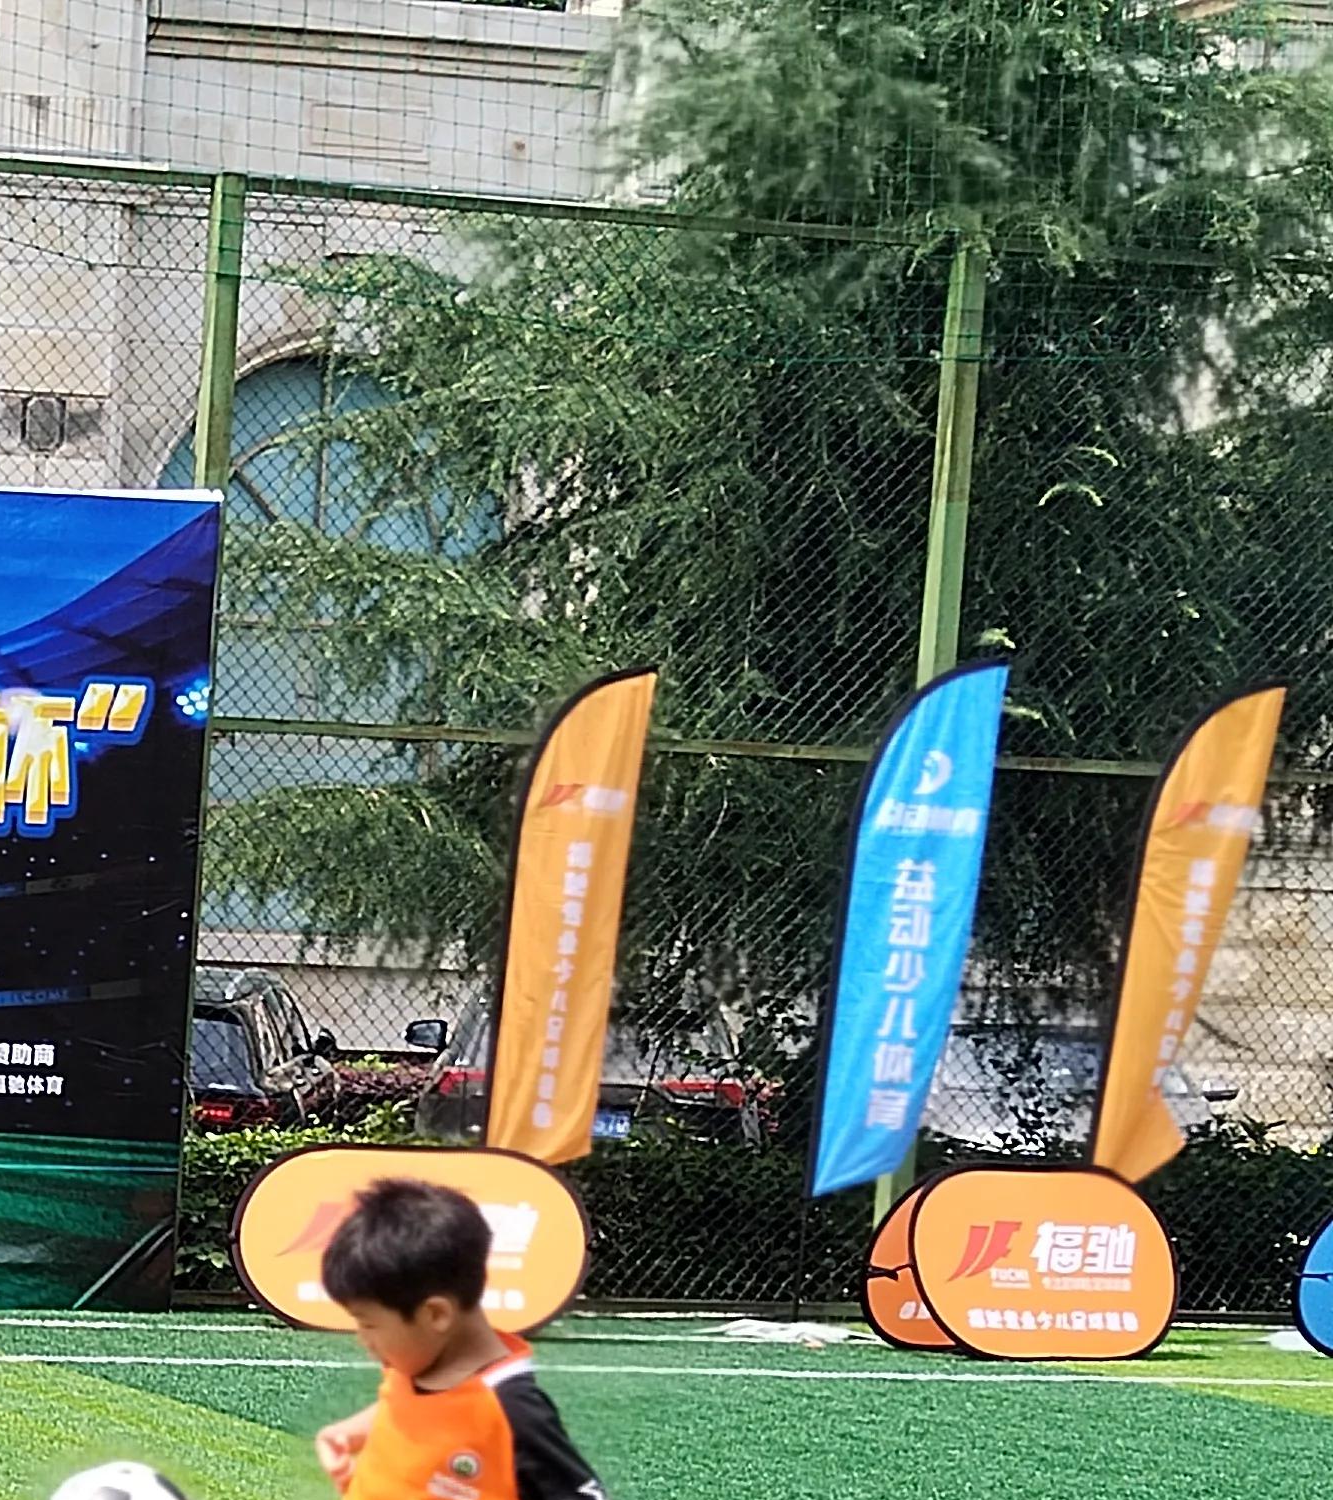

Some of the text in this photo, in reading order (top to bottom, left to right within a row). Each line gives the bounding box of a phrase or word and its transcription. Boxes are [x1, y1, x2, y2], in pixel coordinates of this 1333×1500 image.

[865, 858, 937, 1131] 益动少儿体育
[1030, 1221, 1136, 1275] 福驰
